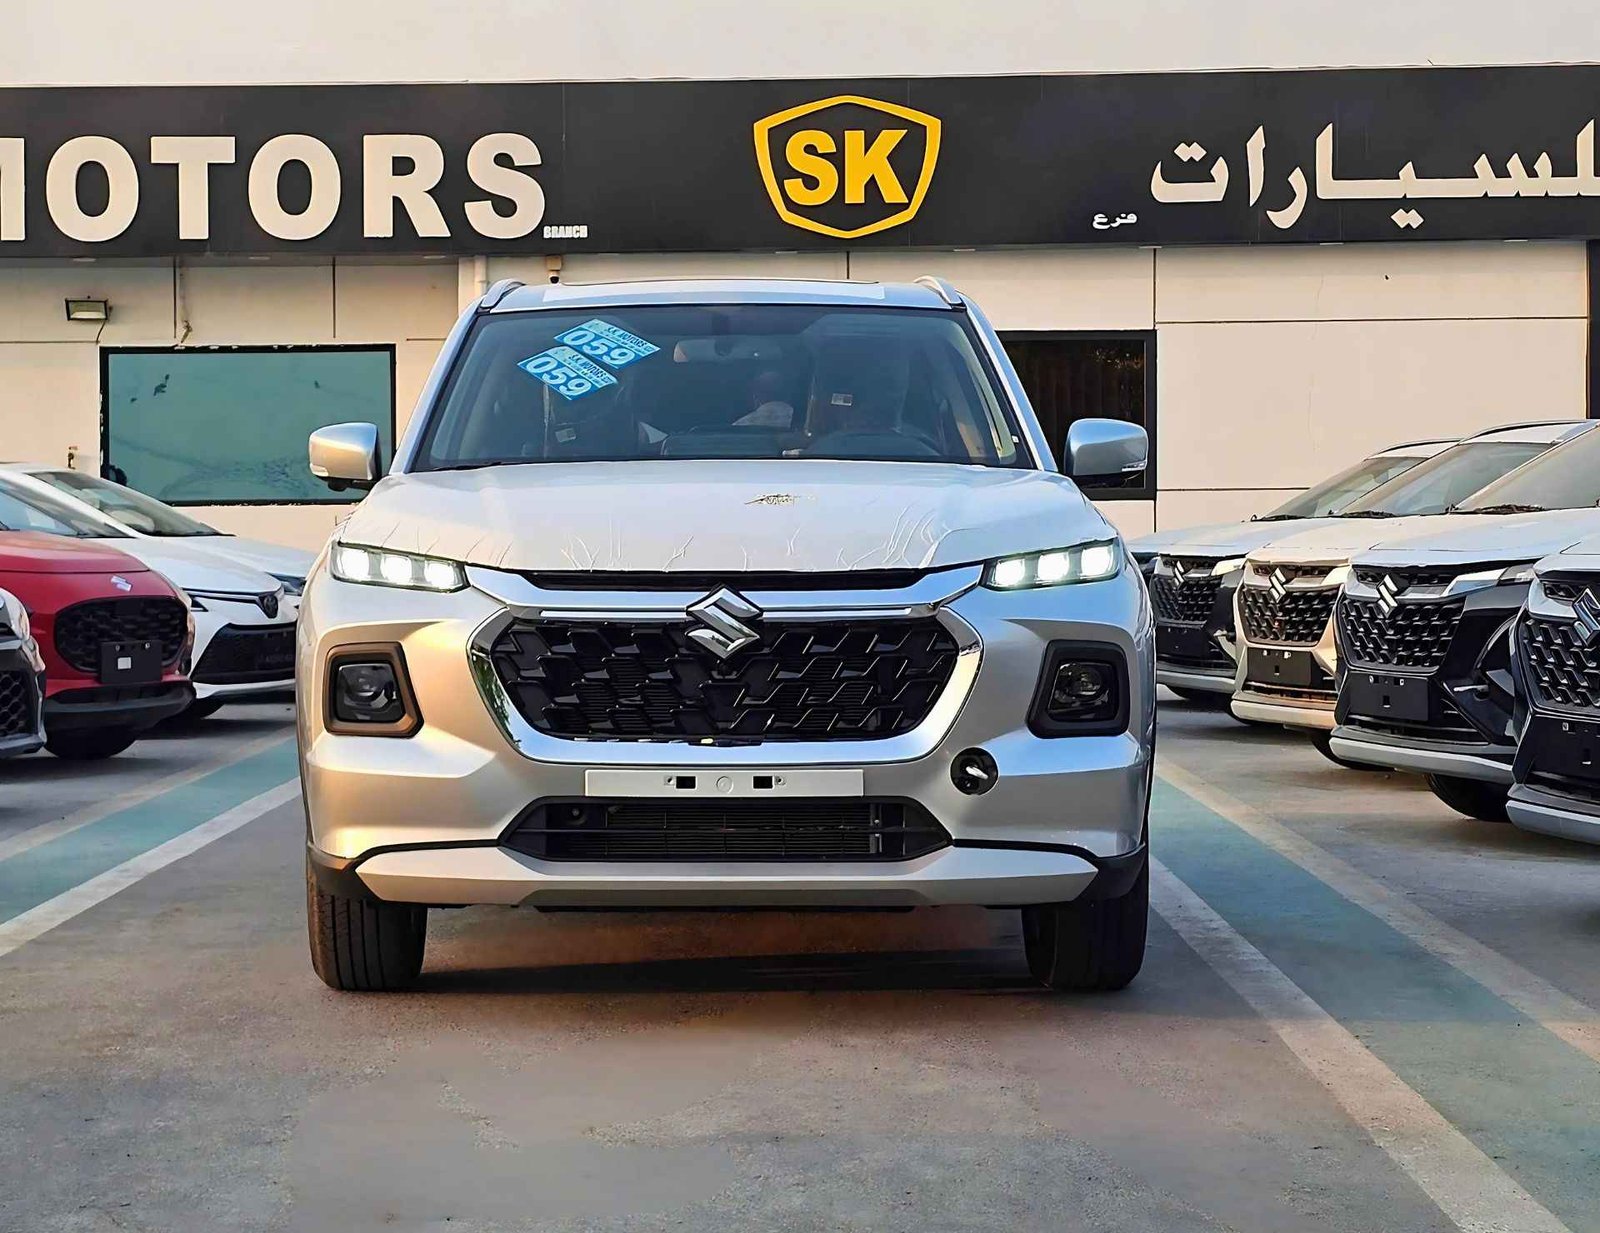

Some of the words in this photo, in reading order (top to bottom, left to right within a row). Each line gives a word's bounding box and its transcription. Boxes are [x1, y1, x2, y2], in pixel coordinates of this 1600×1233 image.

[783, 129, 909, 206] SK
[1150, 118, 1600, 229] لسيارات
[543, 225, 588, 239] BRANCH
[1092, 213, 1138, 230] فرع
[563, 330, 636, 365] 059
[526, 356, 592, 396] 059
